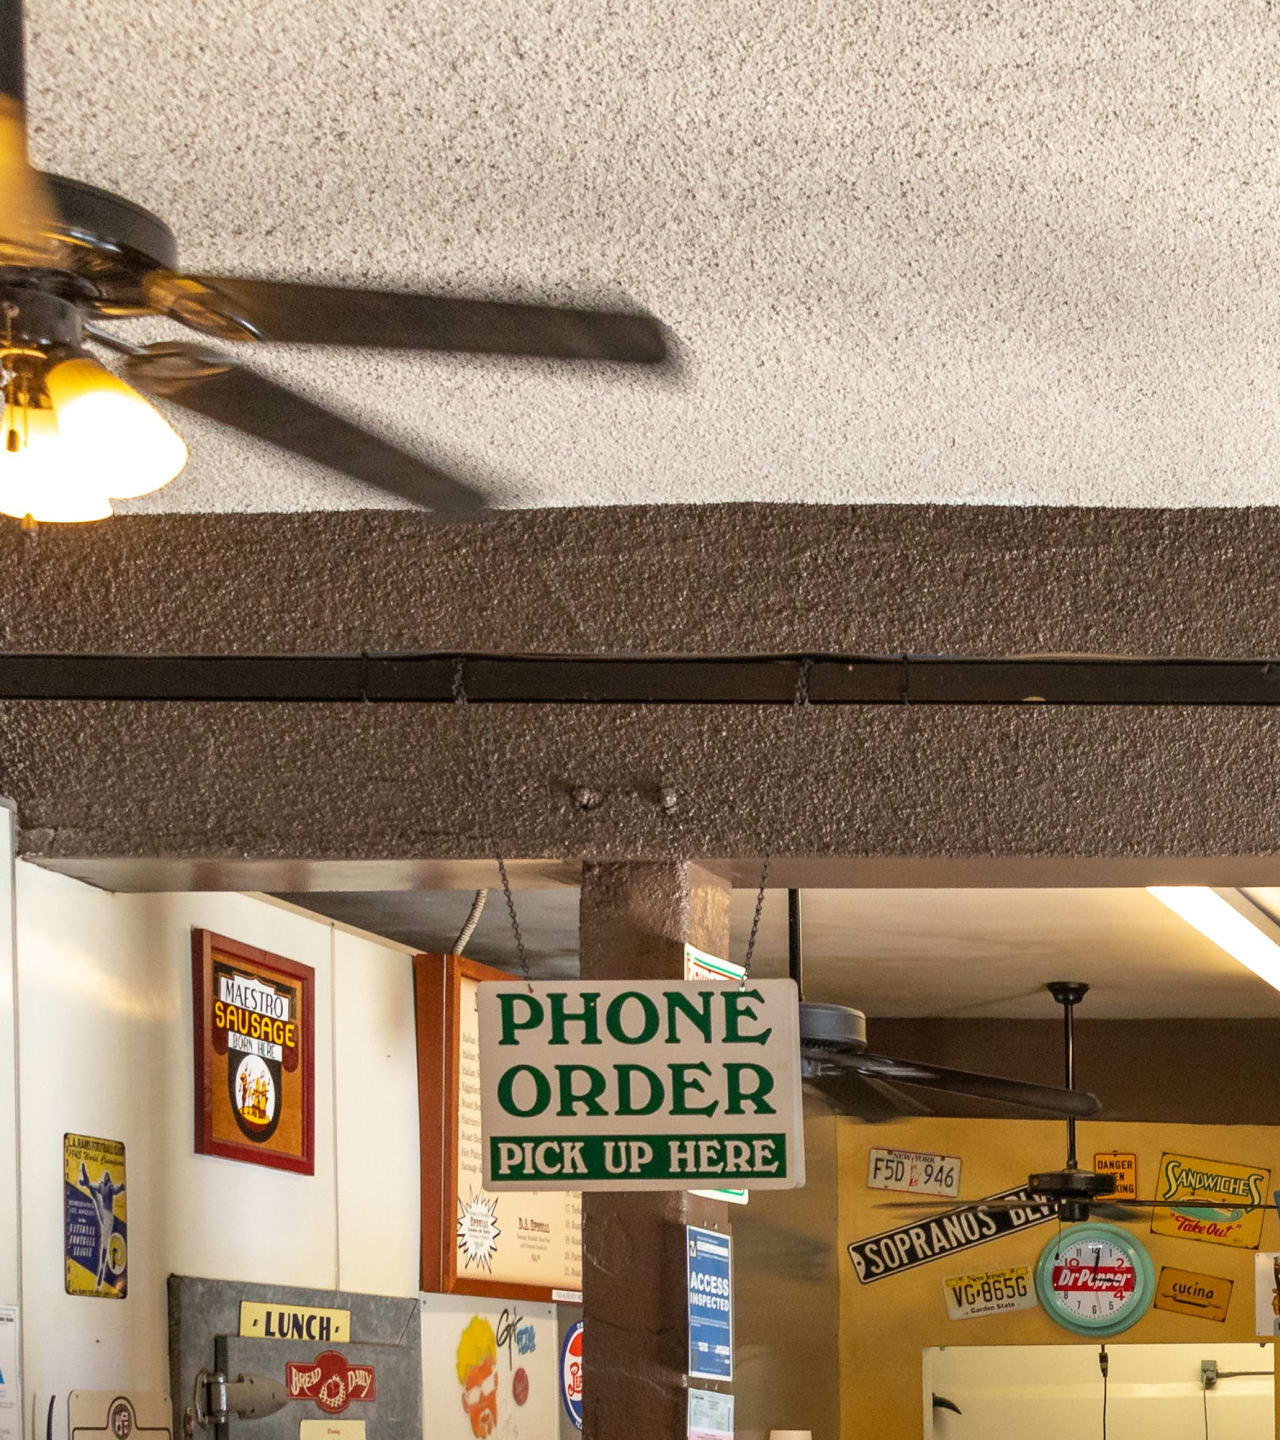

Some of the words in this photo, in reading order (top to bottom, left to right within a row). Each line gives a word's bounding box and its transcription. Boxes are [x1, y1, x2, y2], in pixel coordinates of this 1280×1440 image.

[225, 979, 284, 1019] MAESTRO
[215, 1000, 296, 1048] SAUSAGE
[496, 989, 773, 1046] PHONE
[232, 1033, 254, 1051] BORN
[257, 1041, 276, 1060] HERE
[497, 1061, 777, 1118] ORDER
[498, 1141, 588, 1175] PICK
[603, 1141, 654, 1174] UP
[668, 1139, 779, 1174] HERE
[1097, 1160, 1133, 1169] DANGER
[873, 1157, 905, 1182] F5D
[923, 1163, 954, 1188] 946
[1163, 1160, 1264, 1214] SANDWICHES
[864, 1205, 997, 1273] SOPRANOS
[968, 1274, 983, 1283] New
[984, 1271, 1006, 1284] Jersey
[1064, 1258, 1079, 1268] 10
[1115, 1258, 1125, 1270] 2
[690, 1271, 729, 1297] ACCESS
[1113, 1289, 1125, 1301] 4
[1172, 1282, 1214, 1299] cucina
[689, 1292, 729, 1312] INSPECTED
[970, 1304, 994, 1315] Garden
[995, 1302, 1015, 1311] State
[264, 1311, 331, 1341] LUNCH
[291, 1366, 321, 1396] BREAD
[347, 1369, 372, 1398] DAILY
